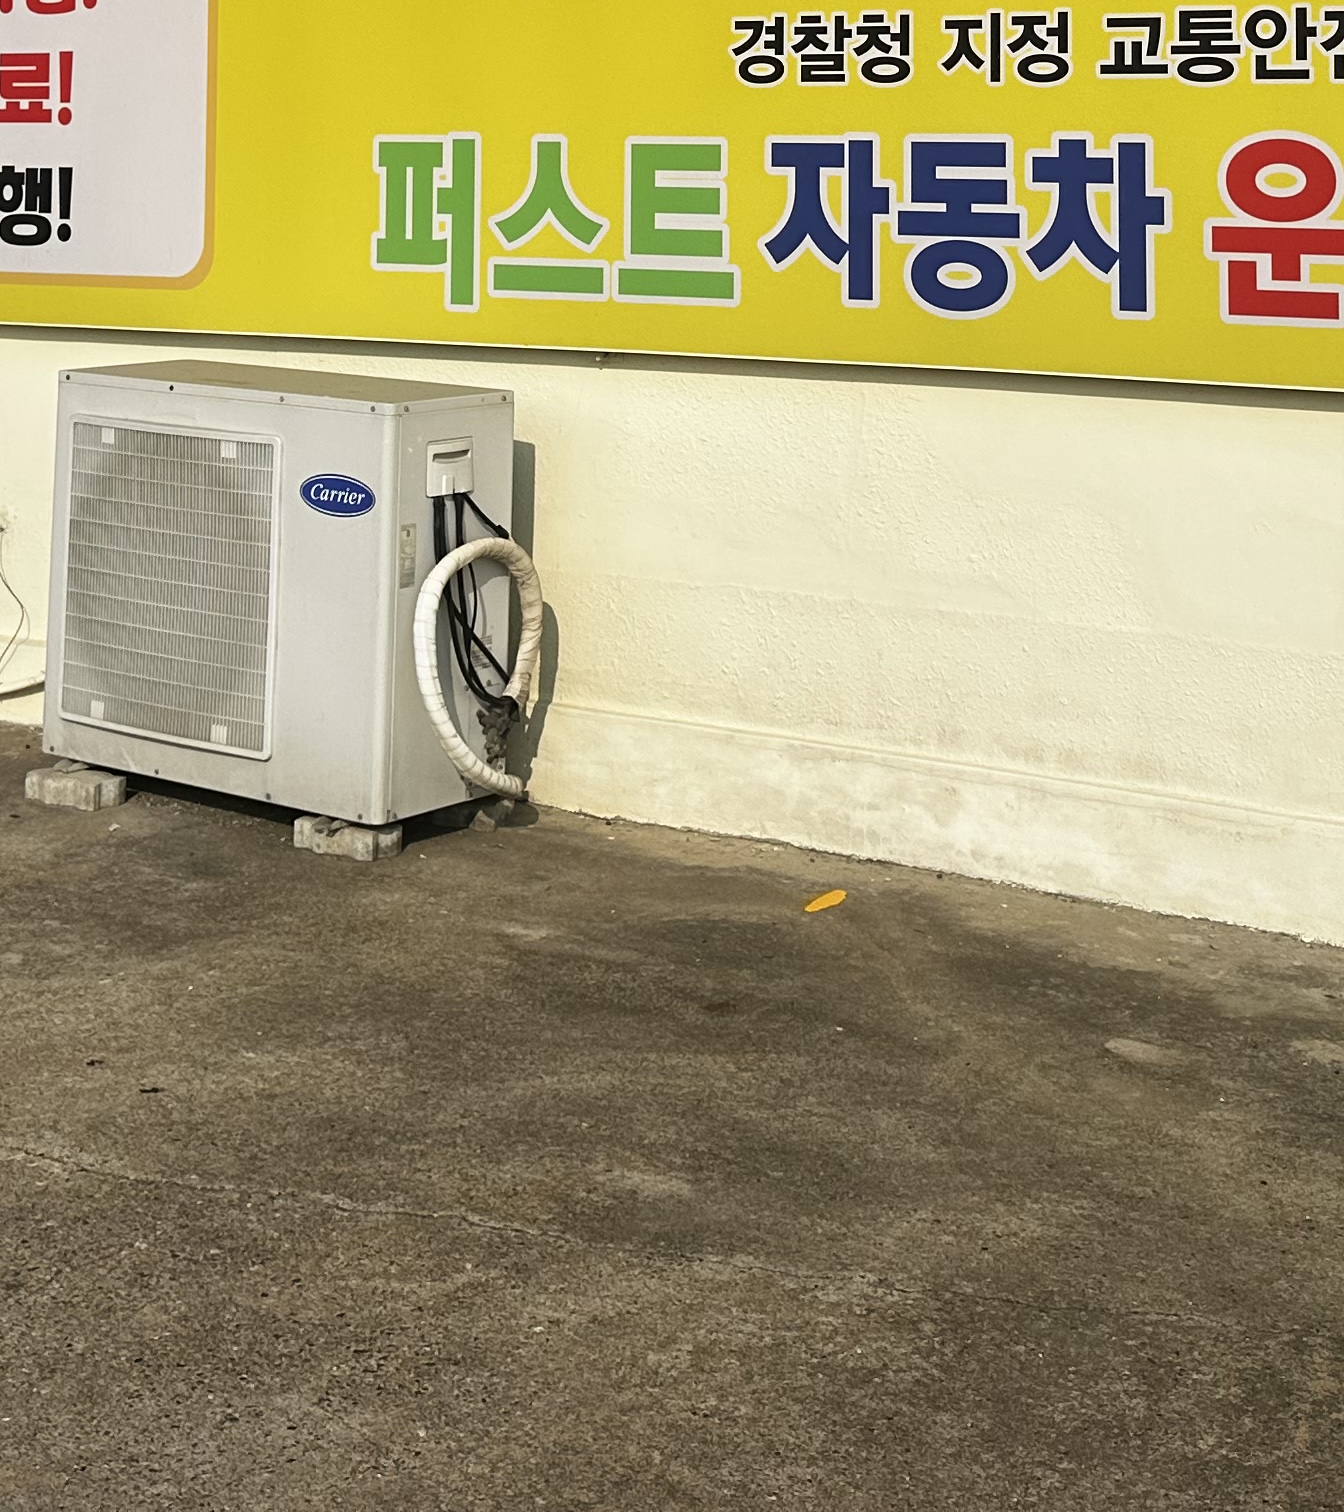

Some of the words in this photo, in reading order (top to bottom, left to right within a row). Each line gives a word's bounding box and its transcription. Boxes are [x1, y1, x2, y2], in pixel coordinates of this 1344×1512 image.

[729, 10, 912, 86] 경찰청
[941, 10, 1070, 85] 지정
[372, 132, 741, 312] 퍼스트
[758, 130, 1172, 320] 자동차
[310, 483, 365, 505] Carrier
